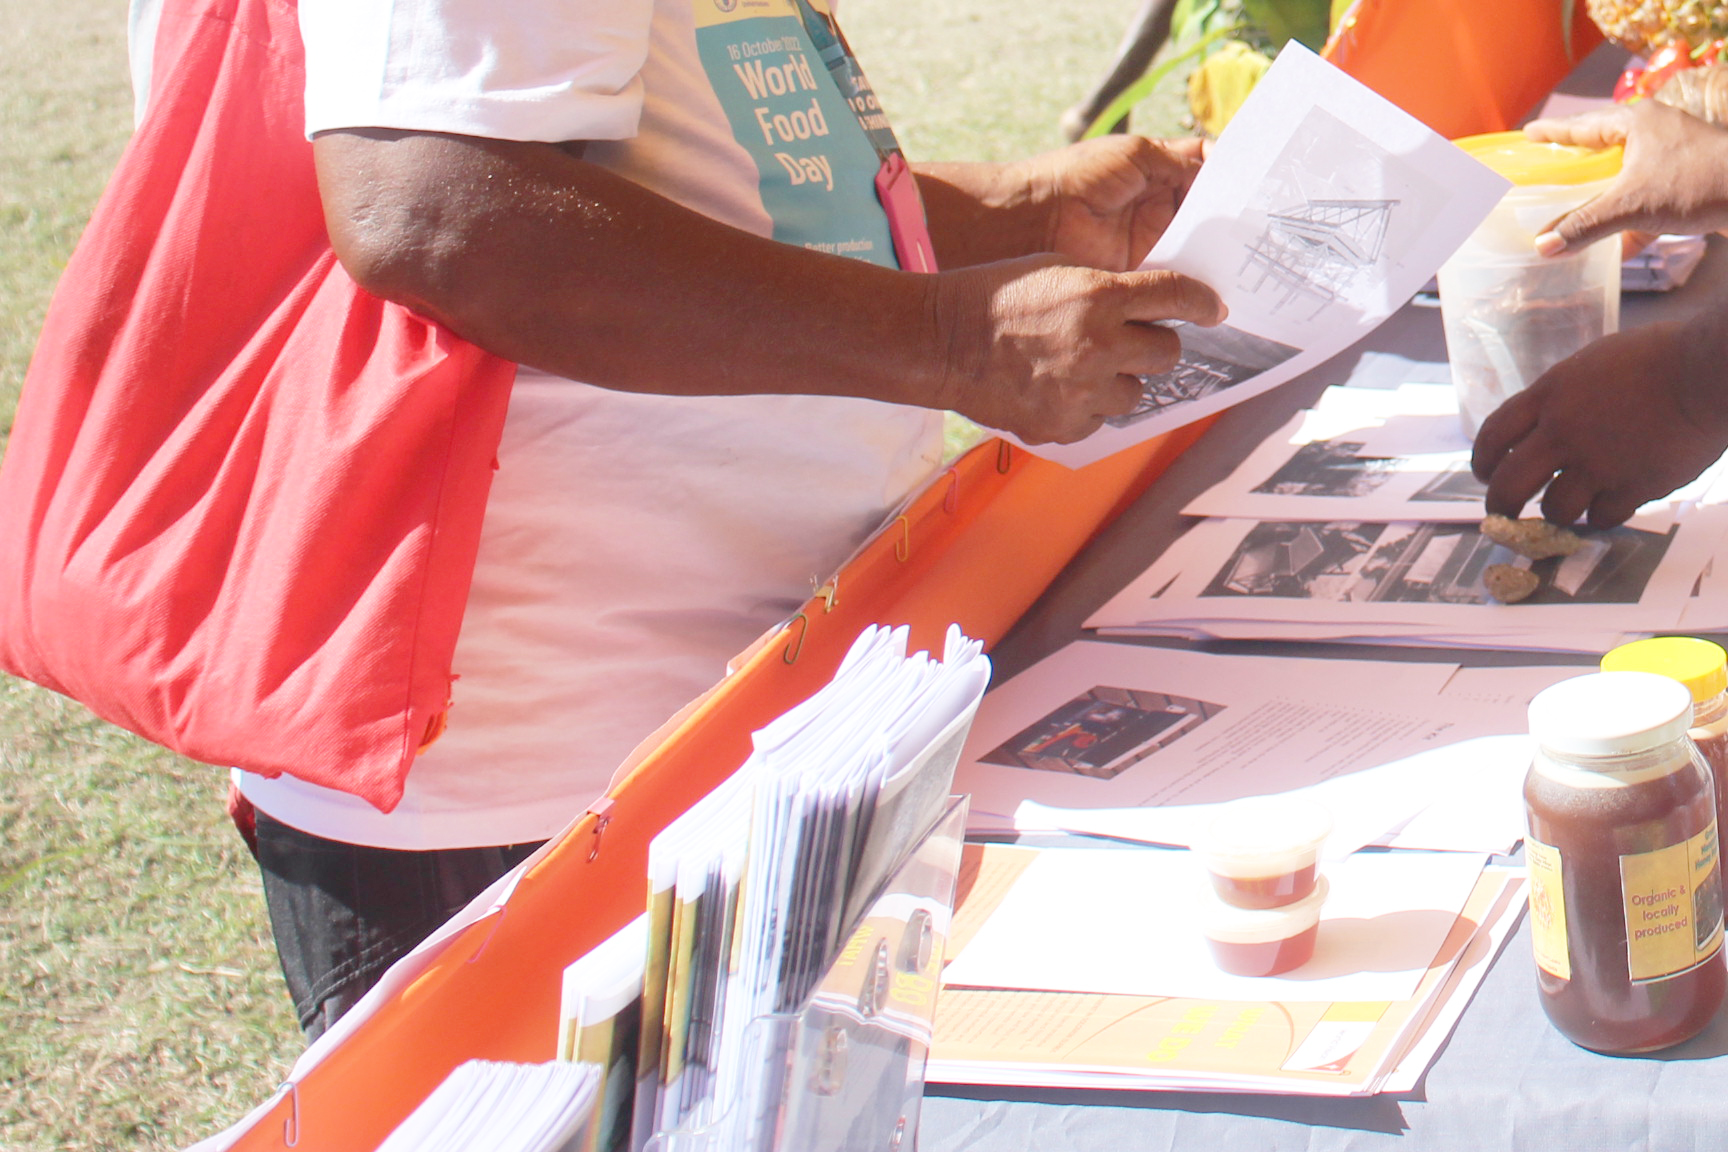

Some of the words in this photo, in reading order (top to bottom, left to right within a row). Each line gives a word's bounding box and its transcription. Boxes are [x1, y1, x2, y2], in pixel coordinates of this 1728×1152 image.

[727, 44, 741, 60] 16
[733, 53, 818, 100] World
[754, 97, 830, 146] Food
[774, 152, 834, 192] Day
[1631, 888, 1677, 906] Organic
[1679, 885, 1686, 895] &
[1634, 916, 1688, 941] produced
[1642, 904, 1680, 921] locally
[1214, 1007, 1264, 1050] WHAT
